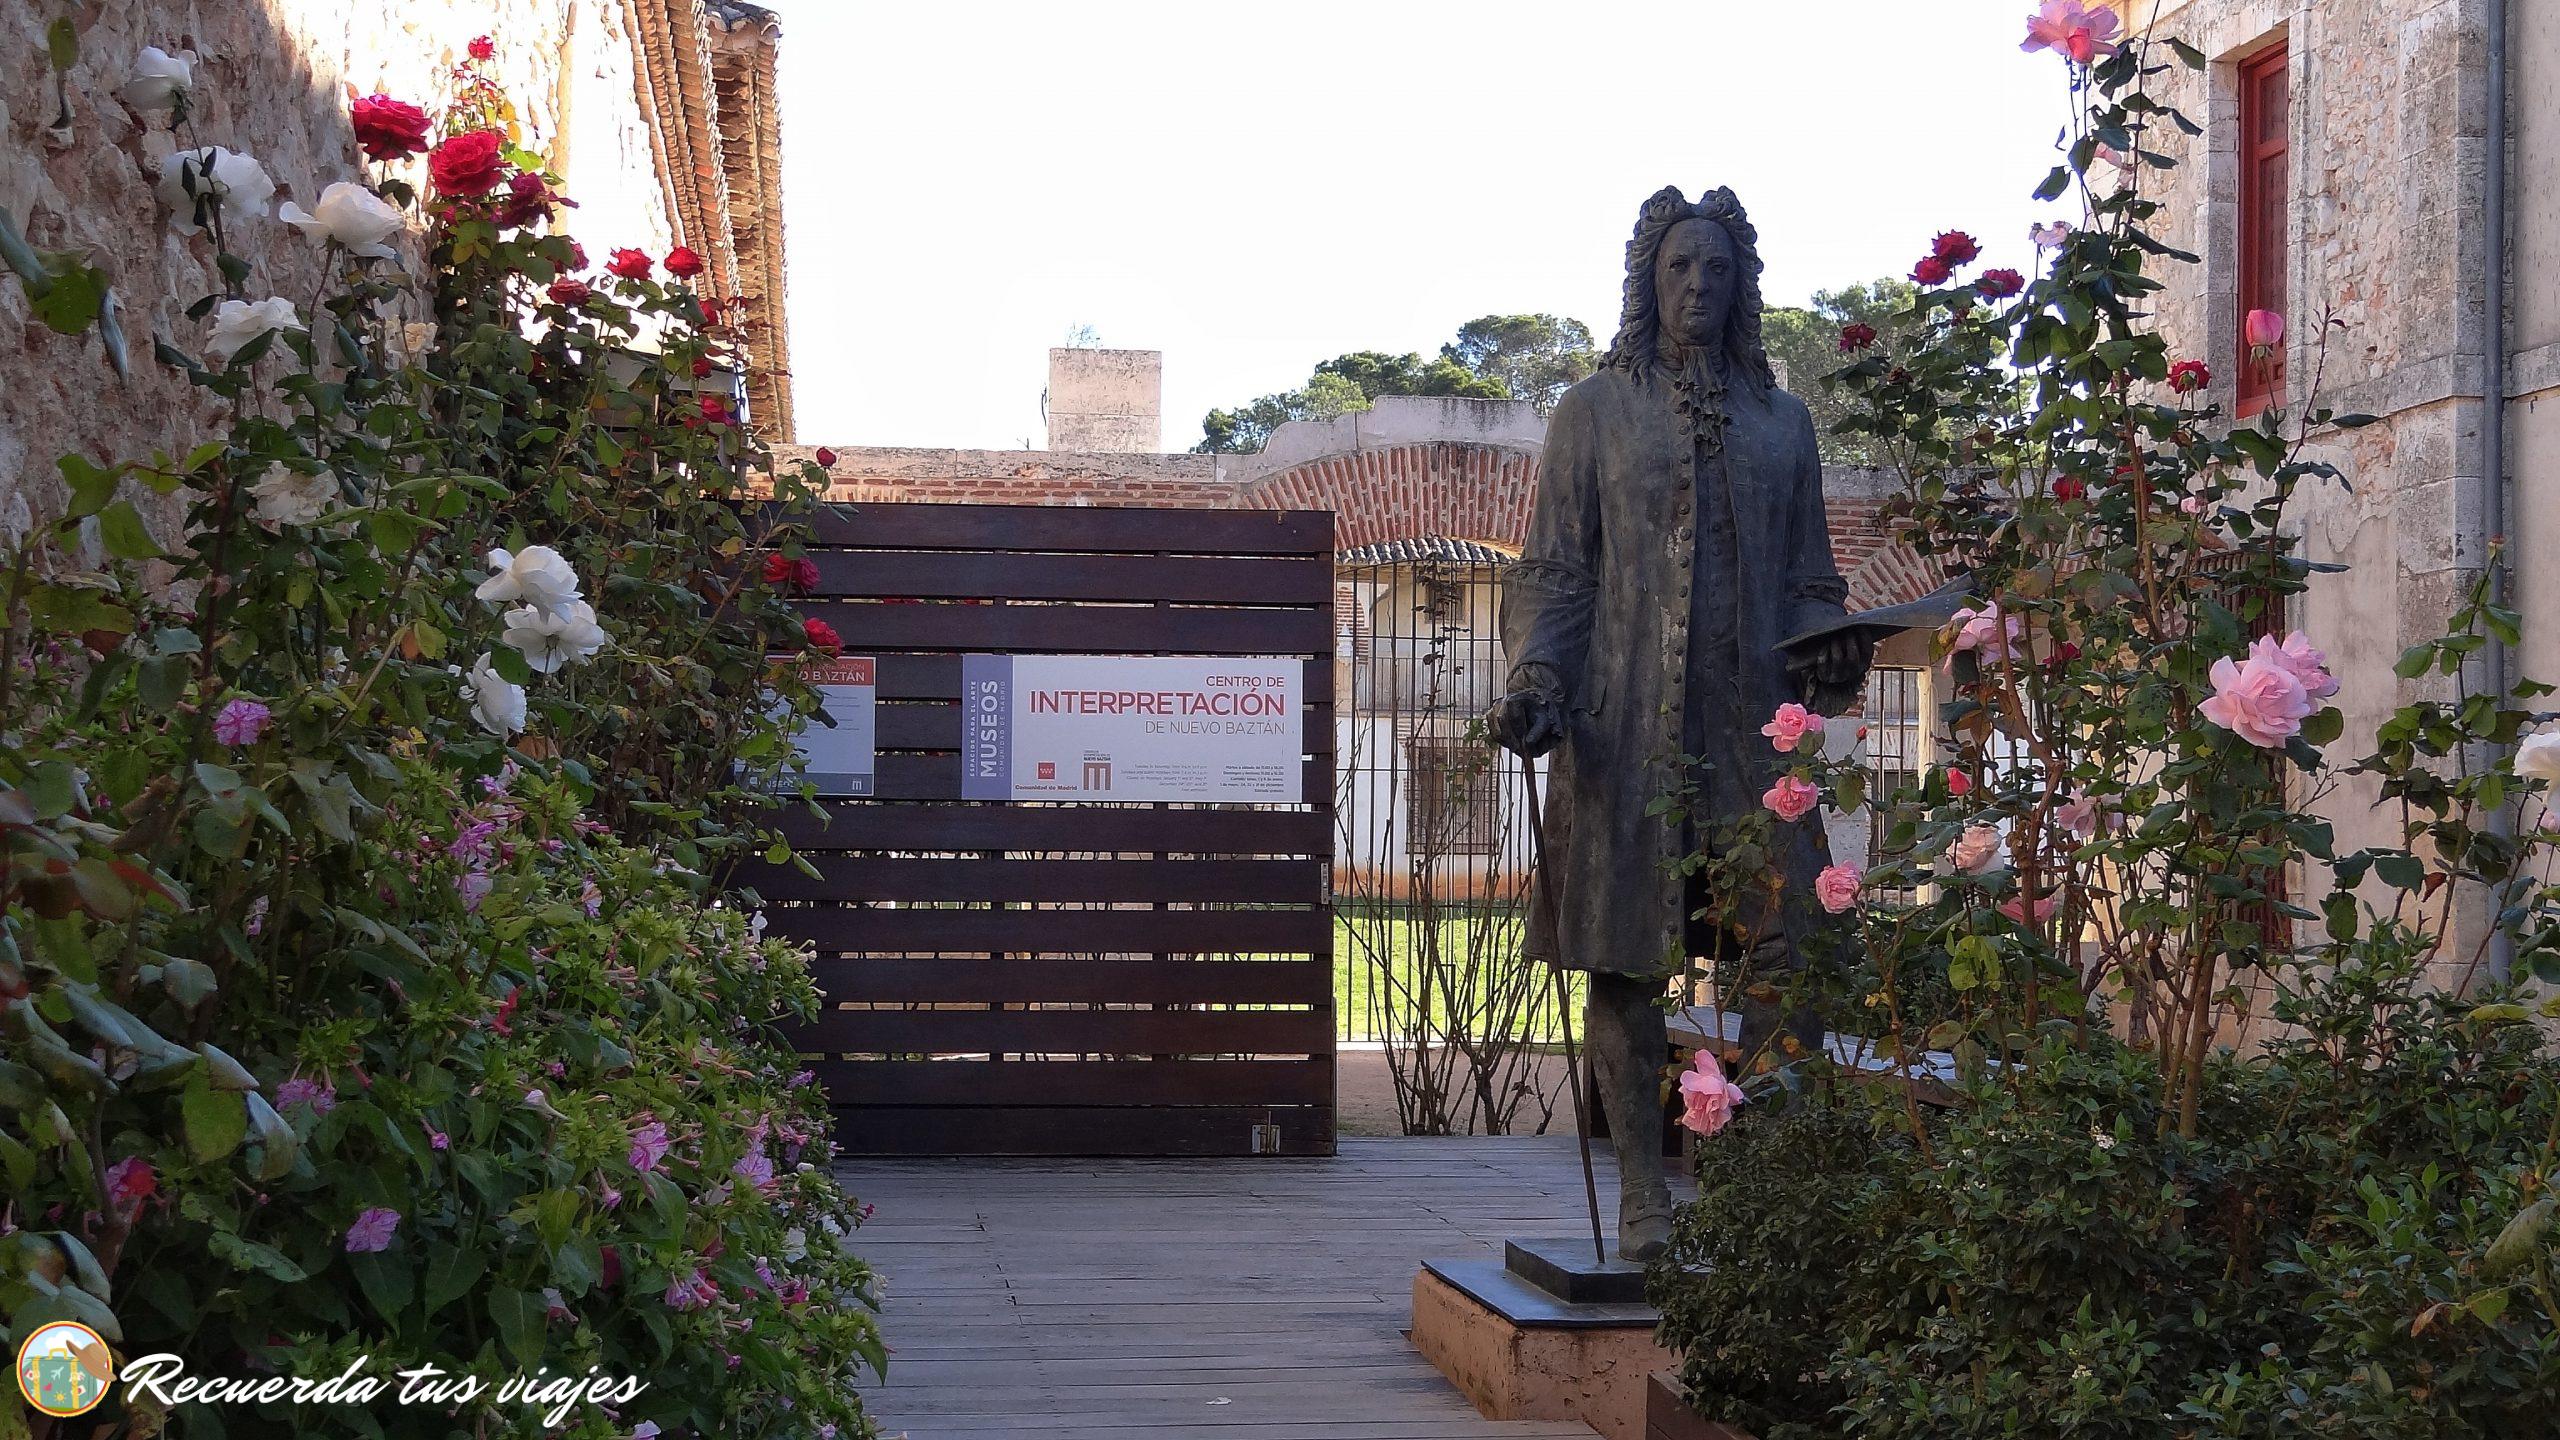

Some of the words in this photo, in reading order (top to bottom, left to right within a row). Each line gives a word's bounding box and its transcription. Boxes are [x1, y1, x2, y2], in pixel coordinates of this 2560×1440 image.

[1205, 675, 1261, 688] CENTRO
[1266, 676, 1285, 688] DE
[970, 703, 976, 713] EL
[1030, 687, 1285, 716] INTERPRETACIÓN
[980, 680, 998, 777] MUSEOS
[999, 716, 1006, 726] DE
[1145, 720, 1165, 735] DE
[1170, 720, 1221, 735] NUEVO
[1226, 719, 1285, 736] BAZTÁN
